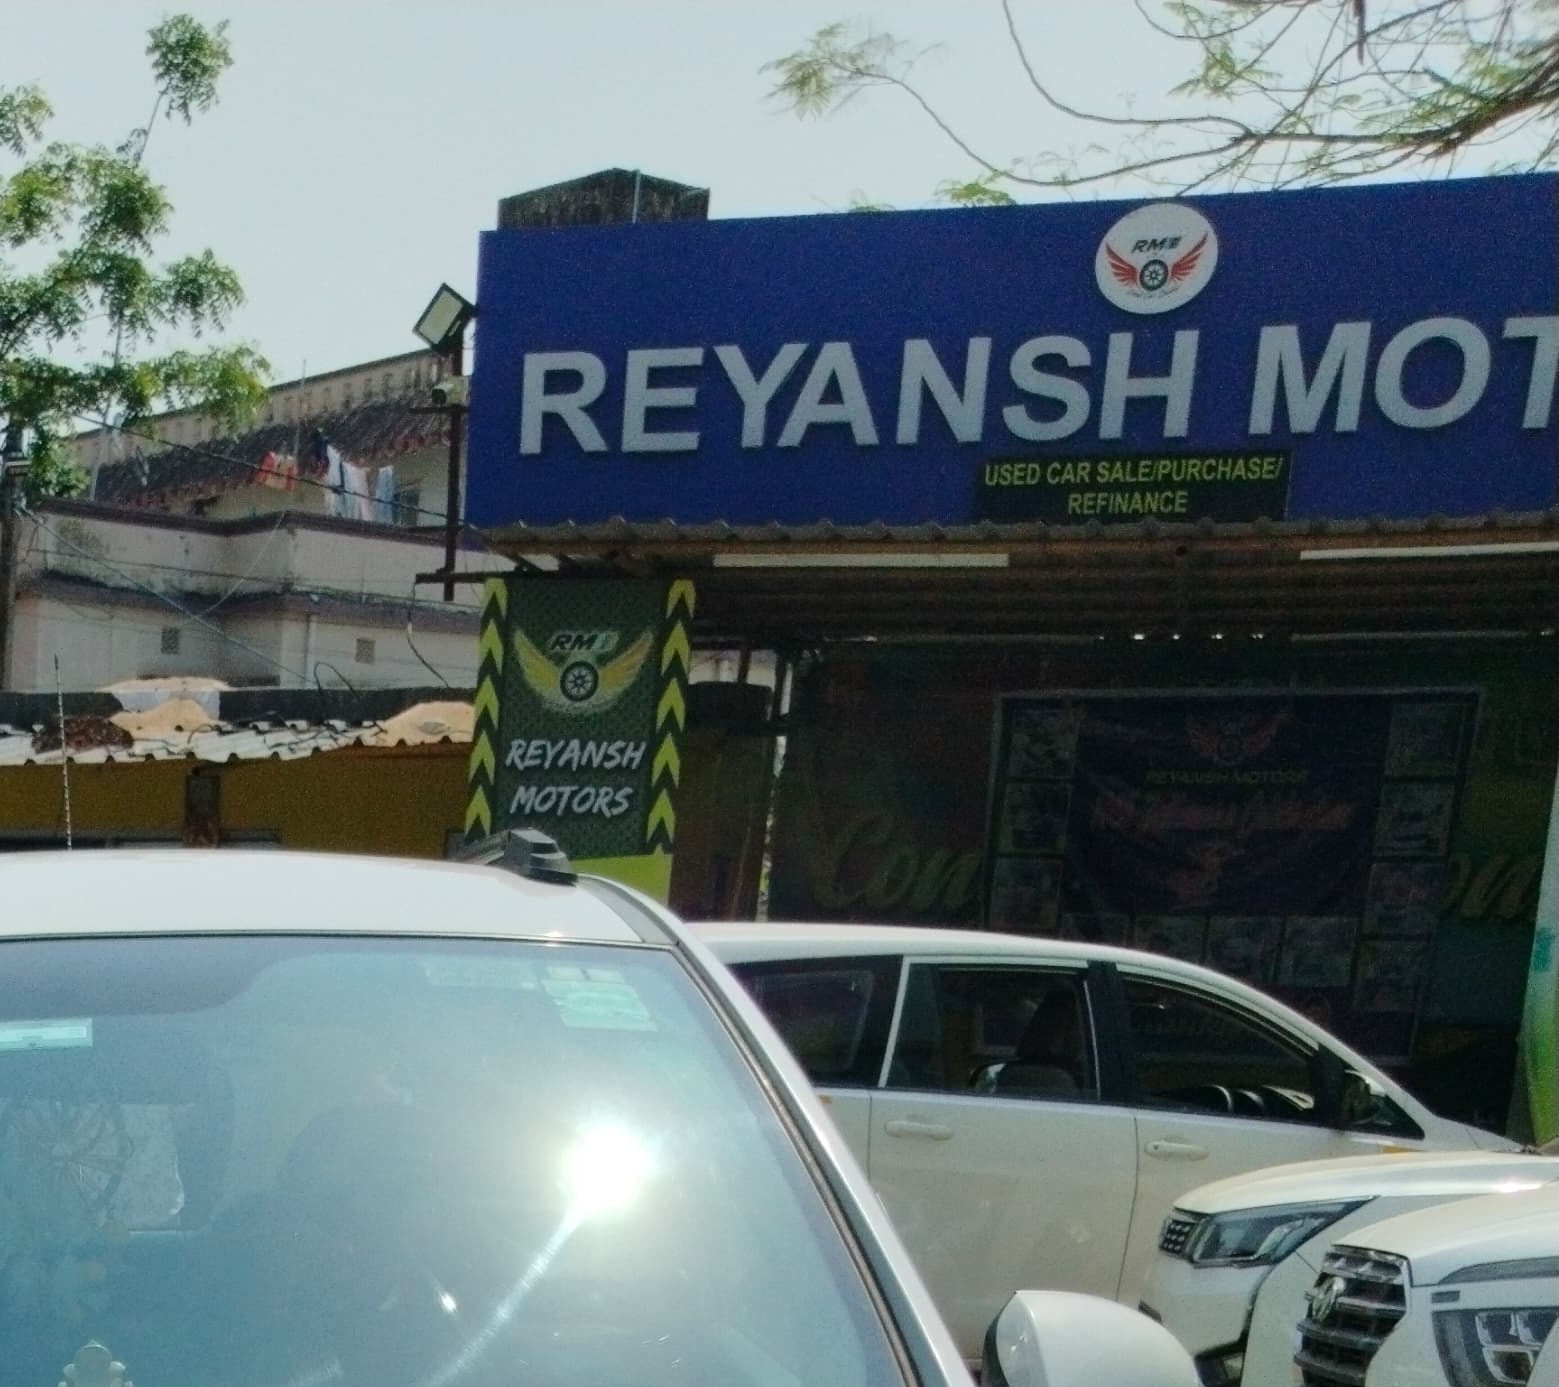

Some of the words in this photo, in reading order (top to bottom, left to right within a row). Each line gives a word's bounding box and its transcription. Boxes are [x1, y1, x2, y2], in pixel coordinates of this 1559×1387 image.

[520, 330, 1200, 455] REYANSH
[1248, 315, 1559, 437] MOT
[984, 462, 1040, 486] USED
[1046, 461, 1090, 485] CAR
[1096, 457, 1284, 484] SALE/PURCHASE/
[1067, 490, 1189, 515] REFINANCE
[505, 738, 647, 772] REYANSH
[509, 785, 635, 819] MOTORS
